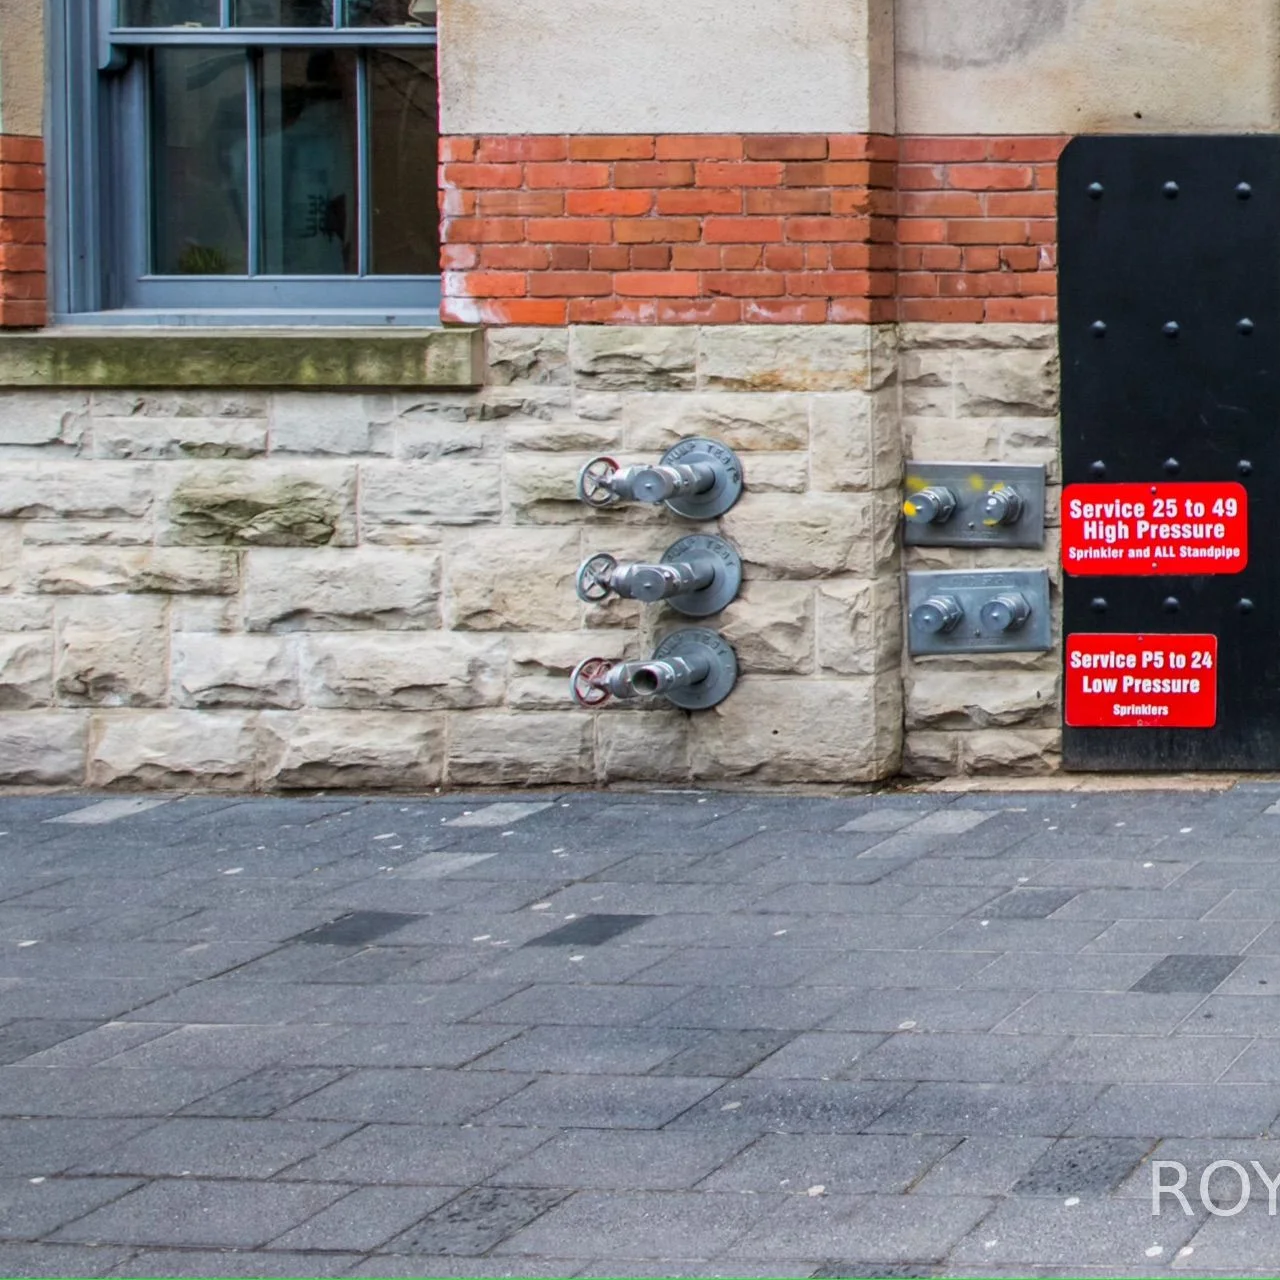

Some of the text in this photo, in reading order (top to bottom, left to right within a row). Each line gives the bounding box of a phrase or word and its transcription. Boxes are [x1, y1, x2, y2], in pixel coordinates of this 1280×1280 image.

[1069, 498, 1238, 518] Service 25 to 49
[1083, 520, 1226, 544] High Pressure
[1068, 545, 1241, 561] Sprinkler and ALL Standpipe
[1070, 650, 1213, 669] Service P5 to 24
[1082, 675, 1201, 694] Low Pressure
[1113, 703, 1169, 717] Sprinklers
